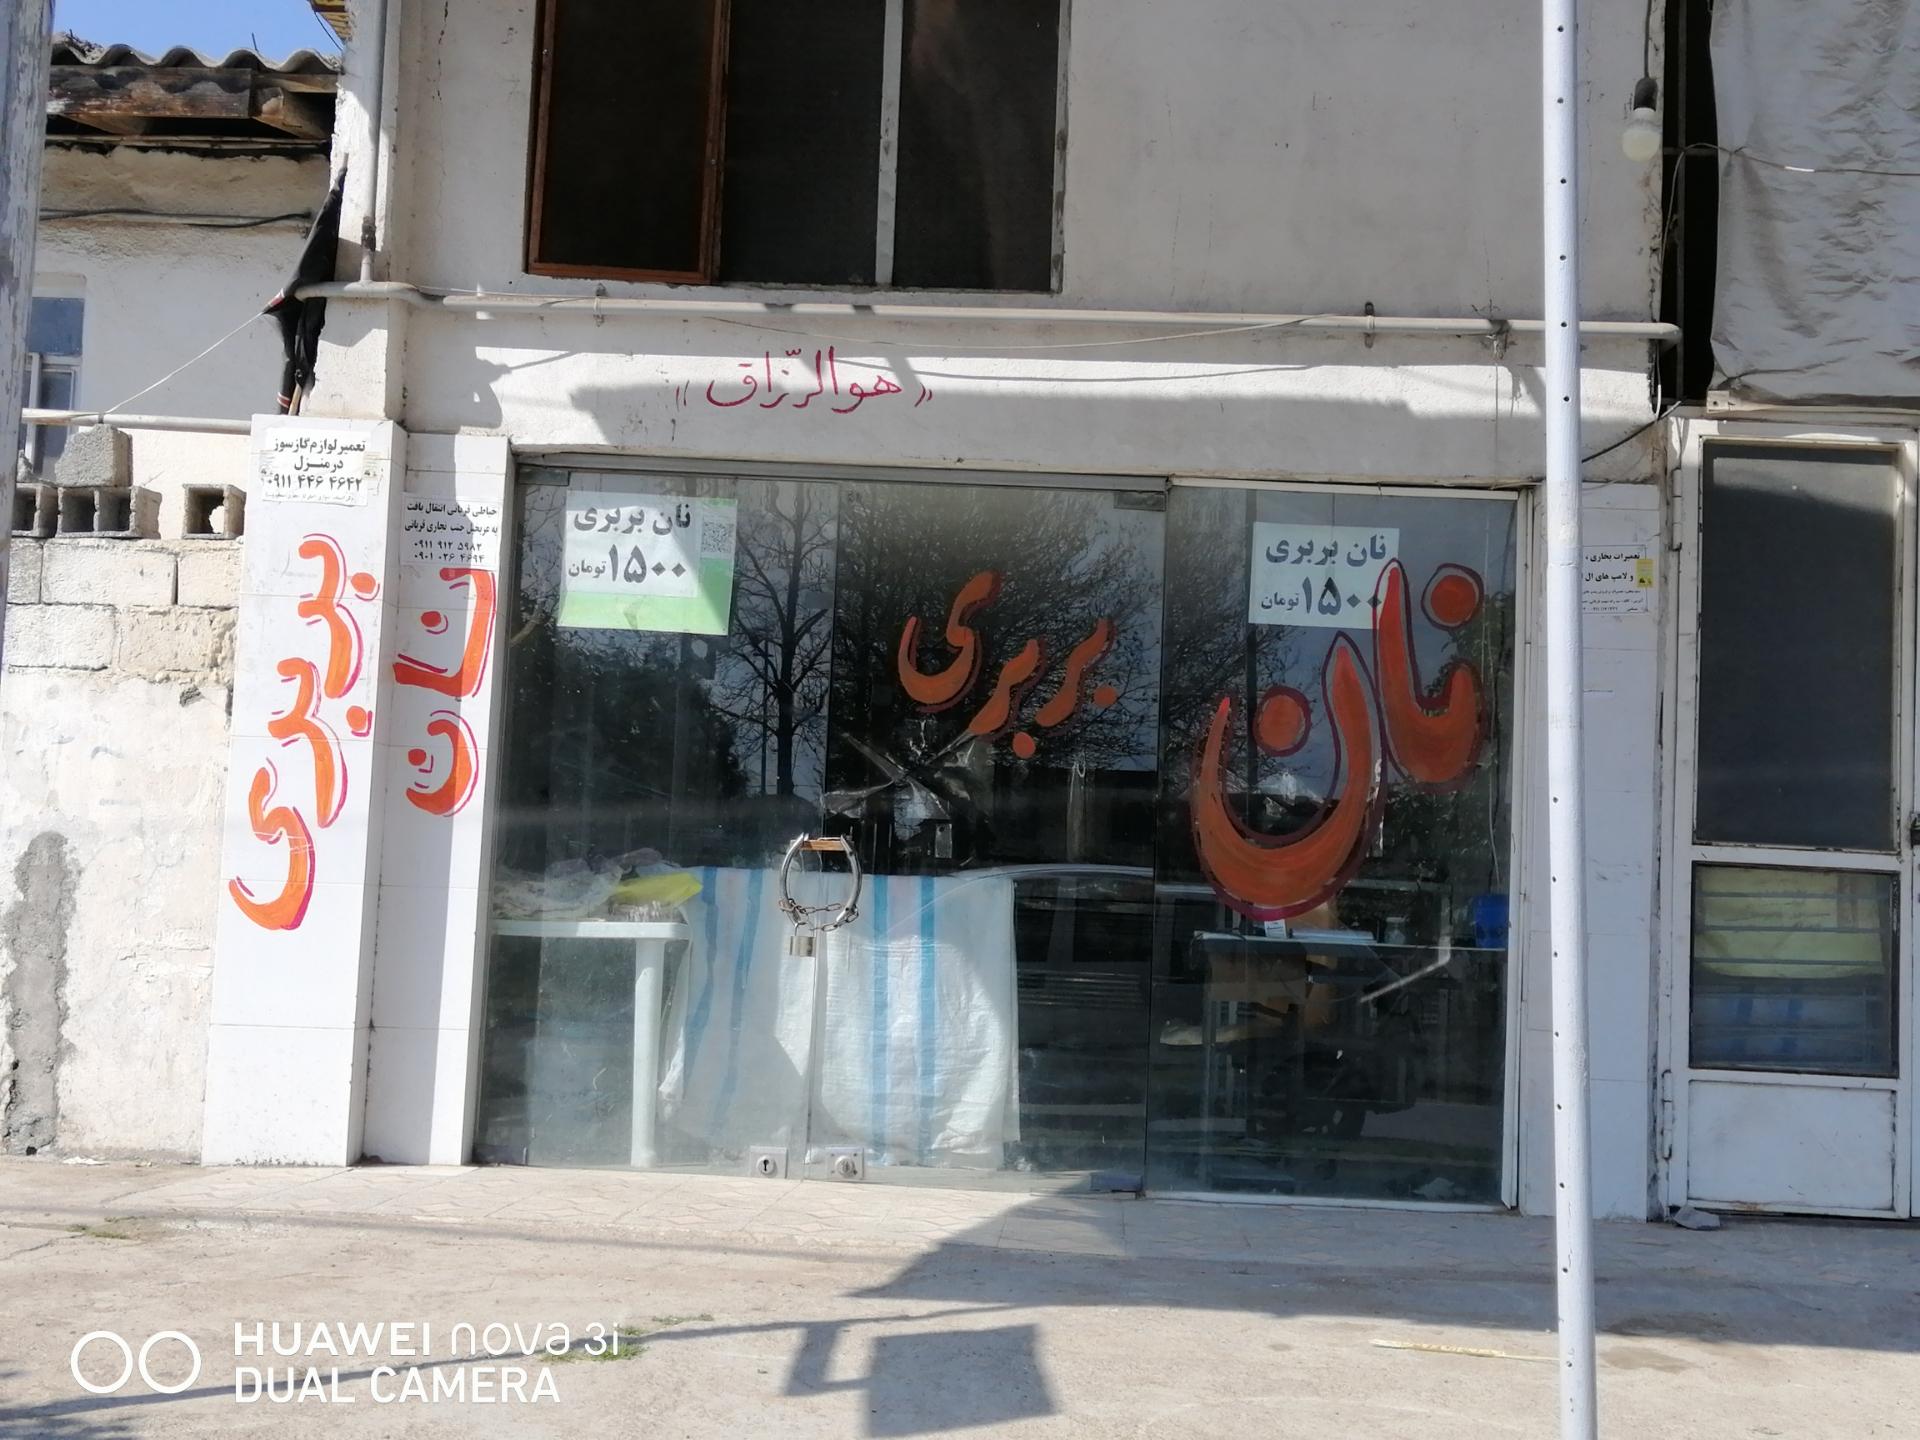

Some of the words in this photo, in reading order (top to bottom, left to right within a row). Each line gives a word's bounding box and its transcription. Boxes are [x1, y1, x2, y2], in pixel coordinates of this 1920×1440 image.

[310, 438, 337, 454] لوازم
[338, 440, 366, 455] تعمیر
[294, 455, 330, 472] منزل
[330, 459, 344, 473] در
[406, 501, 424, 512] یافت
[425, 502, 446, 514] انتقال
[447, 503, 471, 517] قربانی
[404, 519, 426, 533] قربانی
[573, 506, 645, 535] بربری
[652, 503, 691, 536] نان
[1265, 539, 1339, 566] بربری
[1346, 534, 1387, 567] نان
[568, 560, 607, 578] تومان
[608, 544, 687, 584] ۱۵۰۰
[1260, 592, 1300, 611] تومان
[1302, 576, 1382, 616] ۱۵۰۰
[899, 570, 1119, 759] بربری
[393, 566, 498, 819] نان
[229, 533, 380, 930] بربری
[1190, 558, 1485, 922] نان
